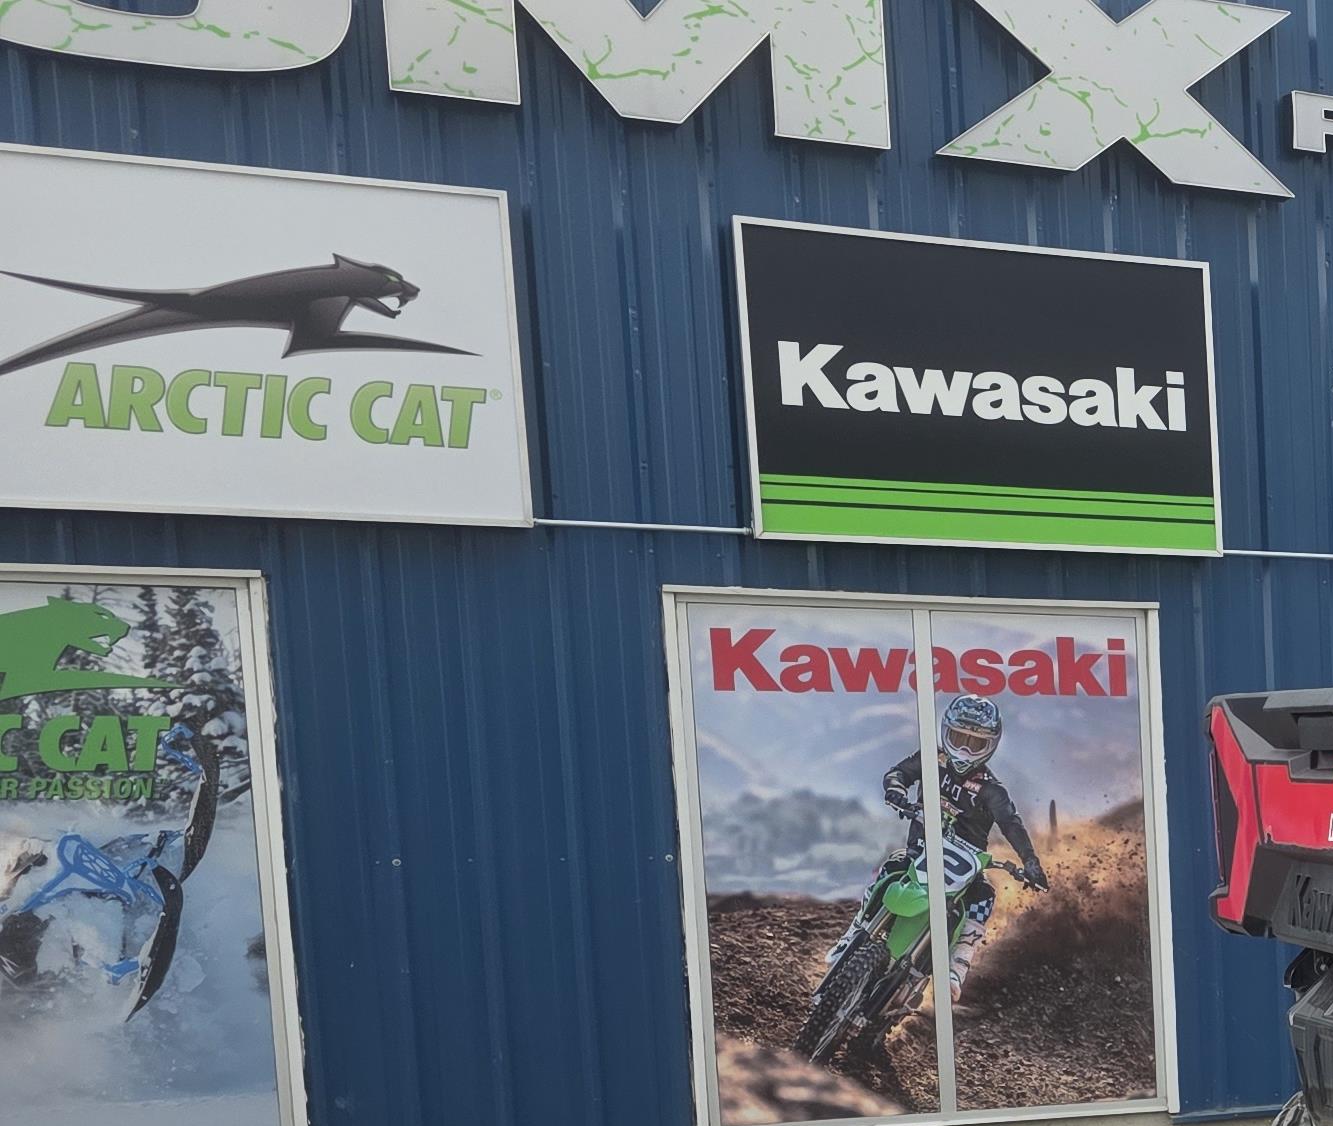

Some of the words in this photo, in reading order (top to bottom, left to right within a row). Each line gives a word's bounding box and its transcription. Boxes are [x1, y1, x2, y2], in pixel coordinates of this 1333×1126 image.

[44, 361, 331, 442] ARCTIC
[349, 380, 487, 449] CAT
[777, 340, 1188, 432] Kawasaki
[709, 627, 1128, 698] Kawasaki
[38, 714, 171, 772] CAT
